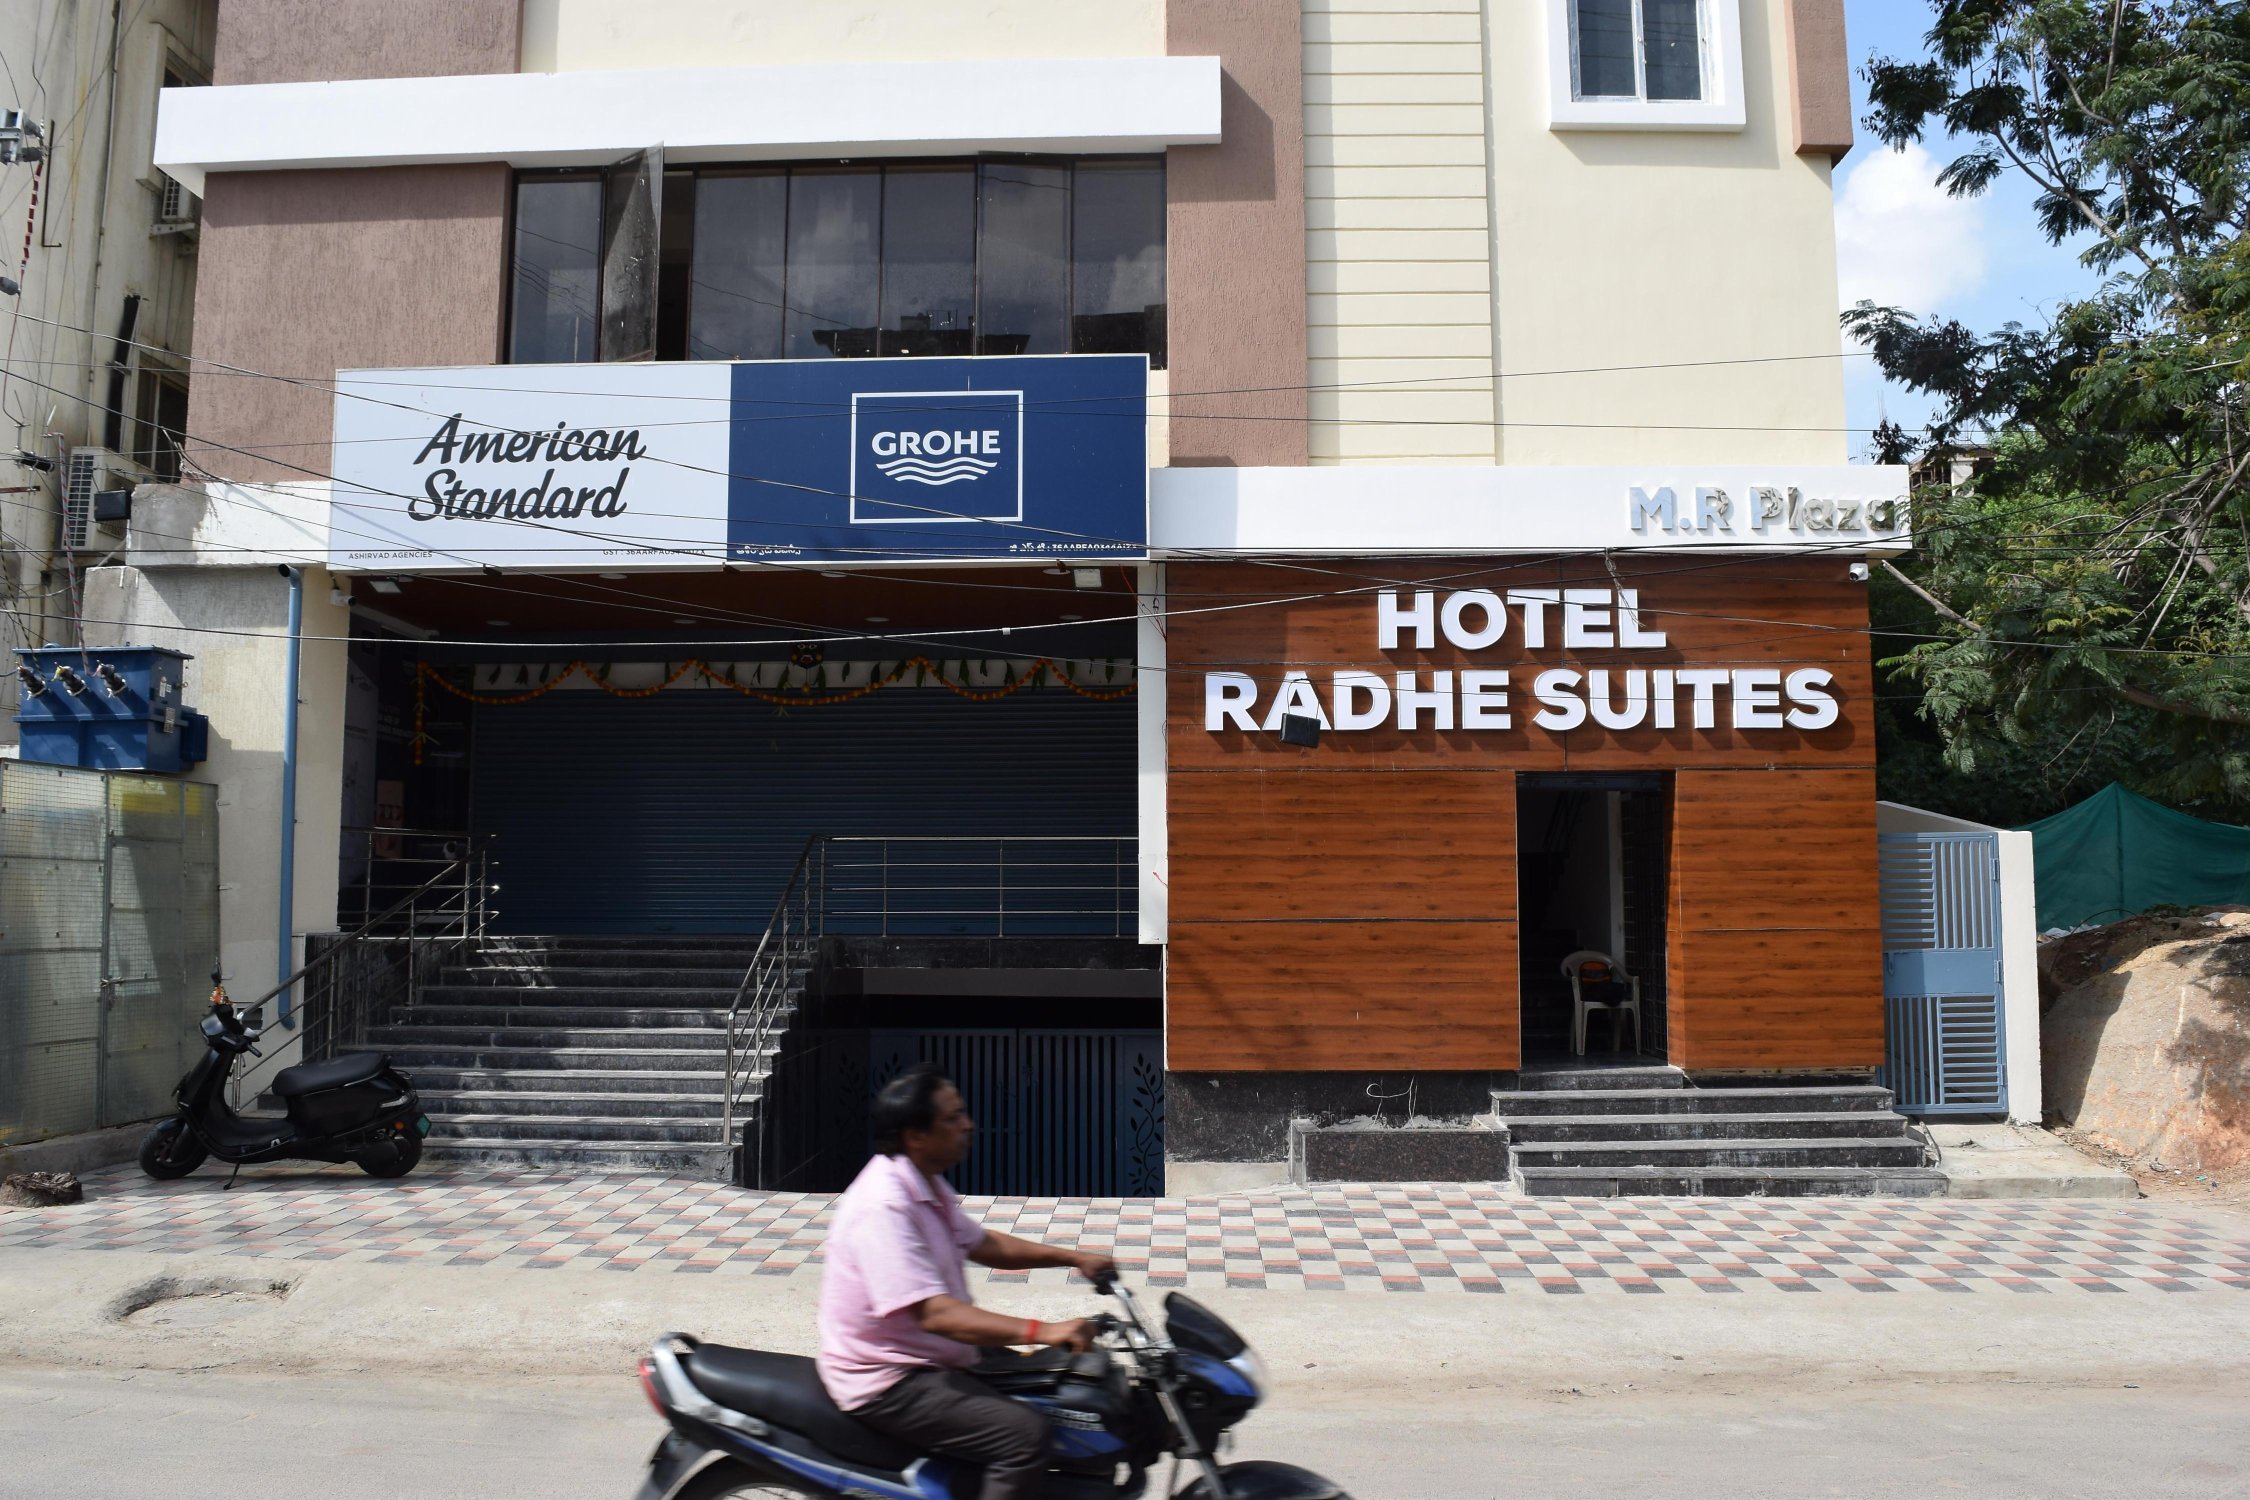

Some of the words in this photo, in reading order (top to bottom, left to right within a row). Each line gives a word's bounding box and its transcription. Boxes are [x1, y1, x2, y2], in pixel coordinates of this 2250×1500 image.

[413, 412, 648, 465] American
[871, 430, 1001, 456] GROHE
[407, 467, 631, 522] Standard
[1629, 486, 1731, 531] M.R
[1749, 486, 1895, 532] Plaza
[348, 552, 390, 560] ASHIRVAD
[392, 551, 433, 559] AGENCIES
[1377, 588, 1666, 650] HOTEL
[1204, 669, 1512, 732] RADHE
[1532, 667, 1839, 731] SUITES
